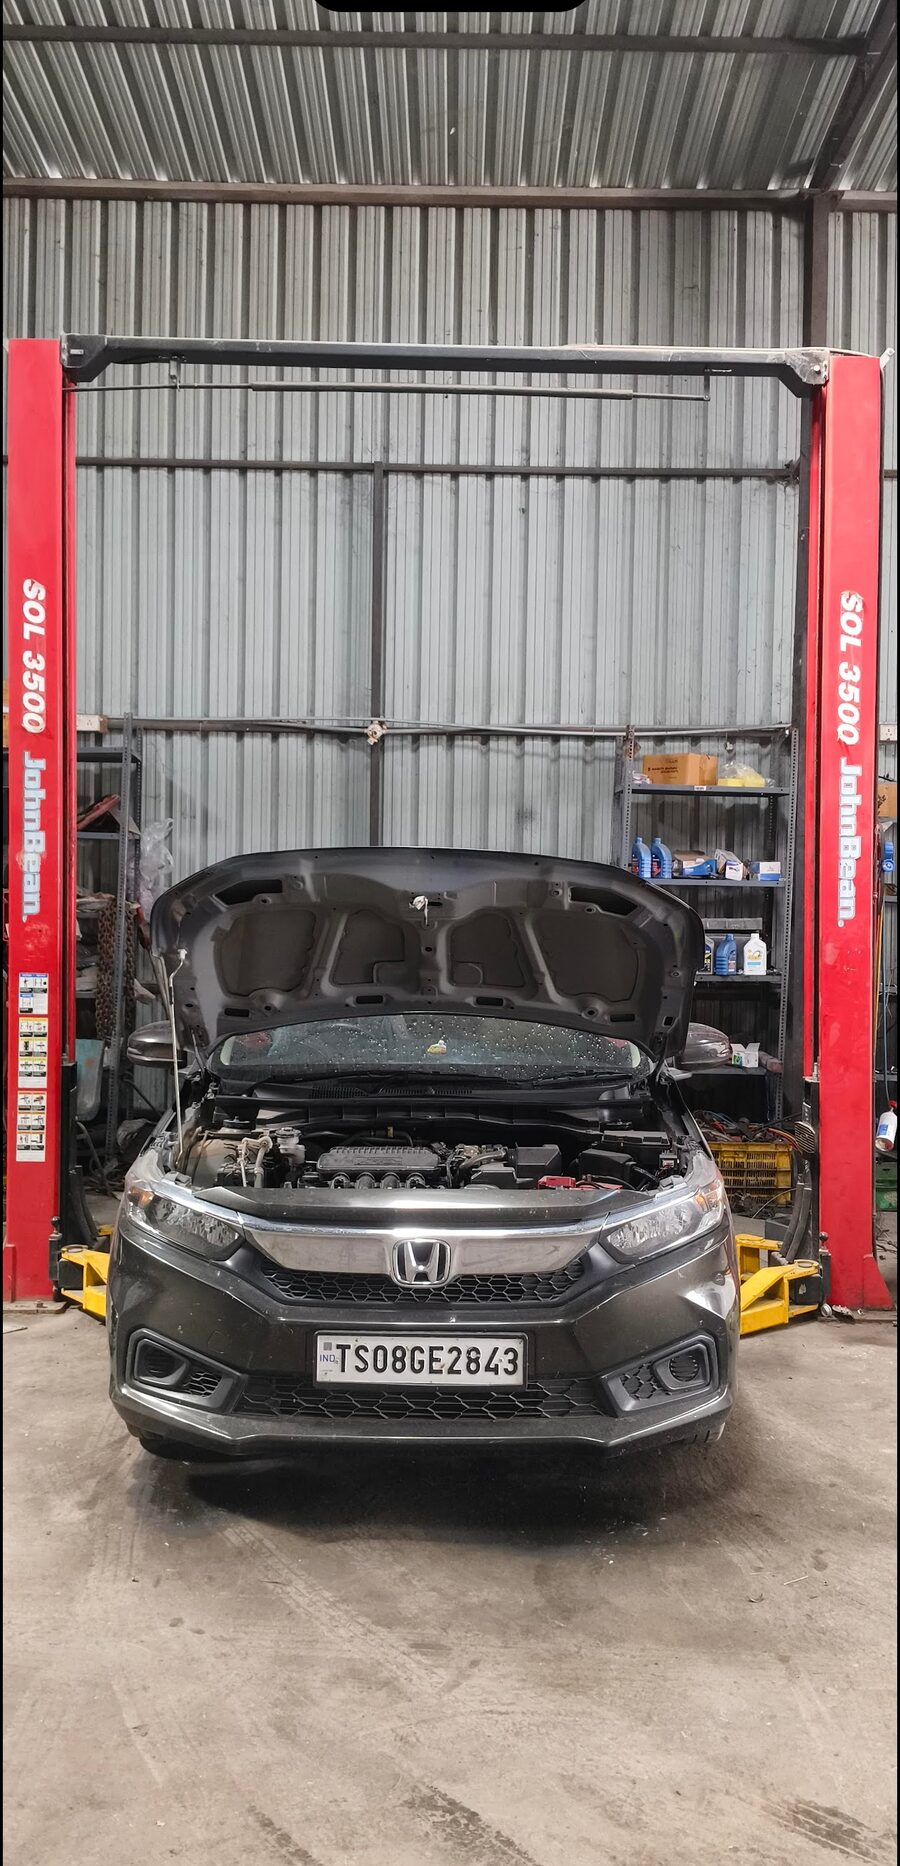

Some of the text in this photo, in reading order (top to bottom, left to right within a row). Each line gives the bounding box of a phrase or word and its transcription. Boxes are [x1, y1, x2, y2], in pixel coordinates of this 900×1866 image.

[22, 578, 46, 640] SOL
[840, 591, 864, 652] SOL
[21, 650, 46, 734] 3500
[837, 661, 861, 745] 3500
[319, 1354, 336, 1363] IND
[336, 1344, 519, 1376] TS08GE2843
